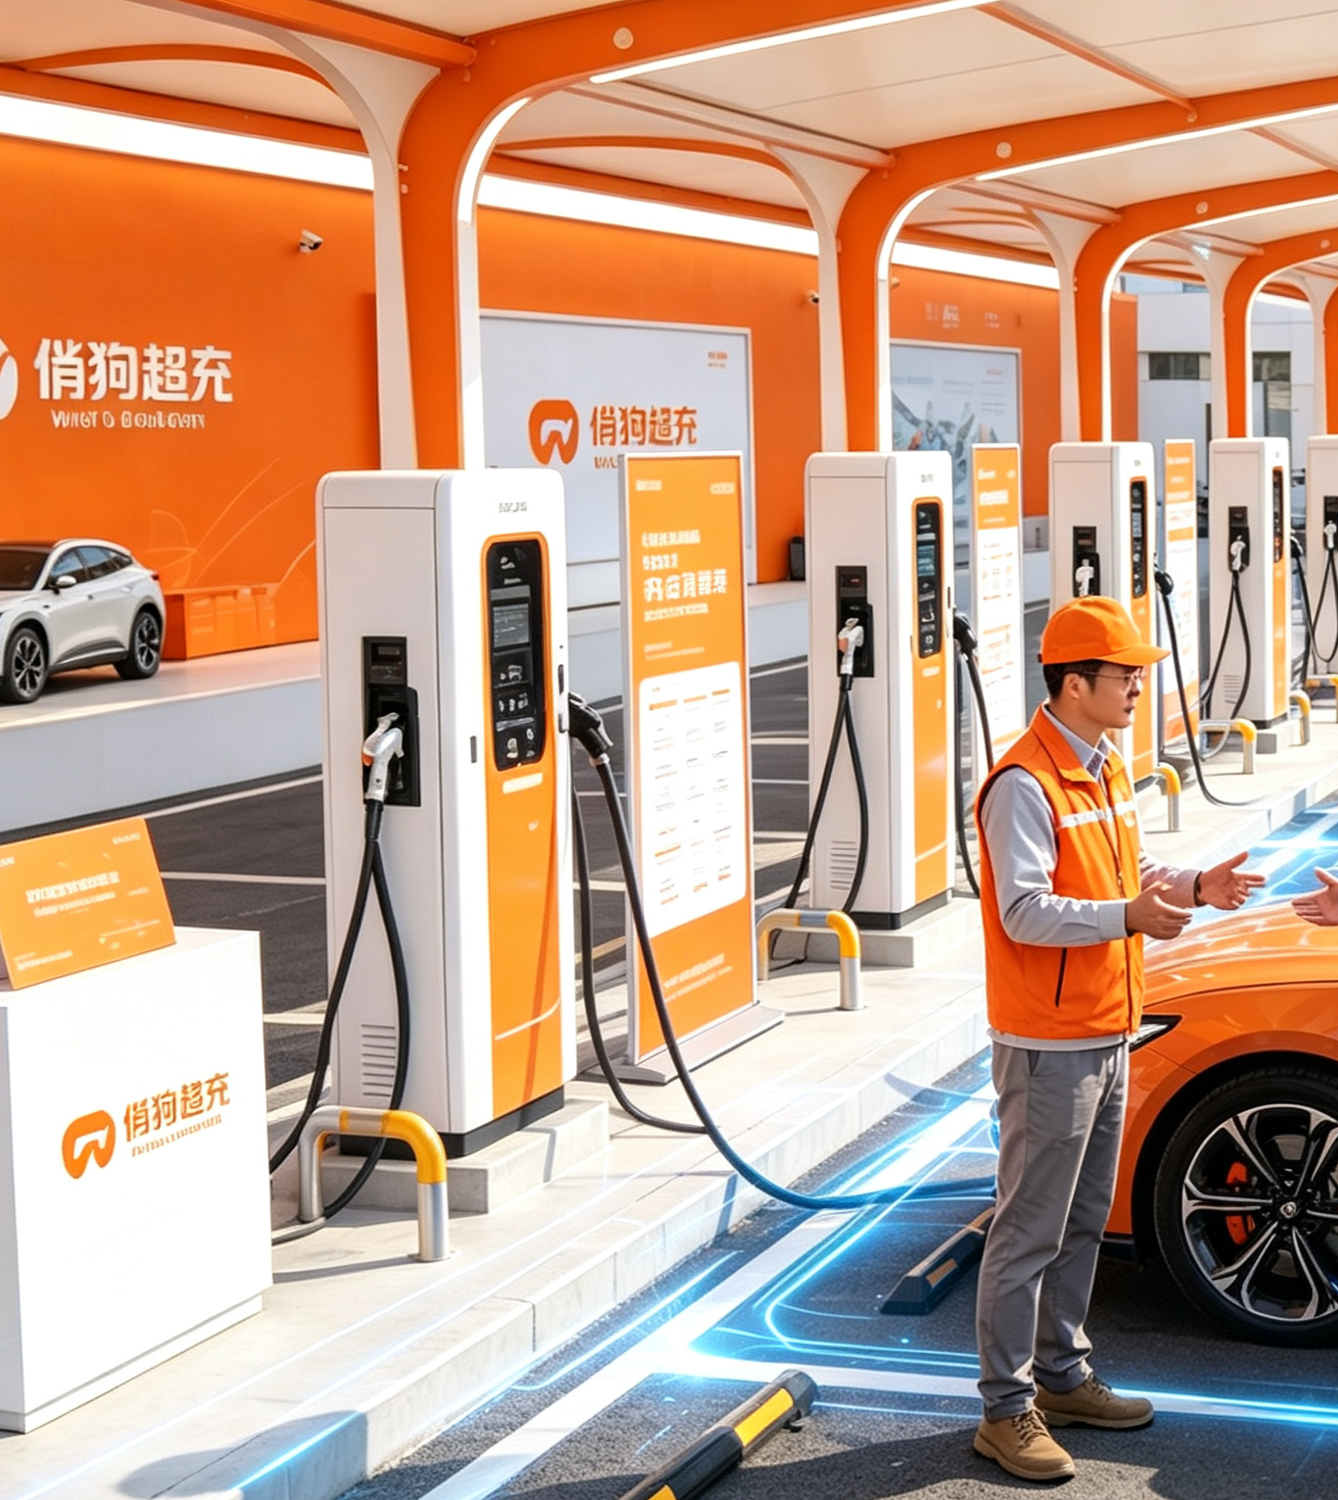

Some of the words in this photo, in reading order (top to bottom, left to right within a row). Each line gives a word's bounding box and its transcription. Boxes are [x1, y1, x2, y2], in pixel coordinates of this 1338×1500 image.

[33, 337, 234, 402] 俏狗超充
[590, 405, 698, 446] 俏狗超充
